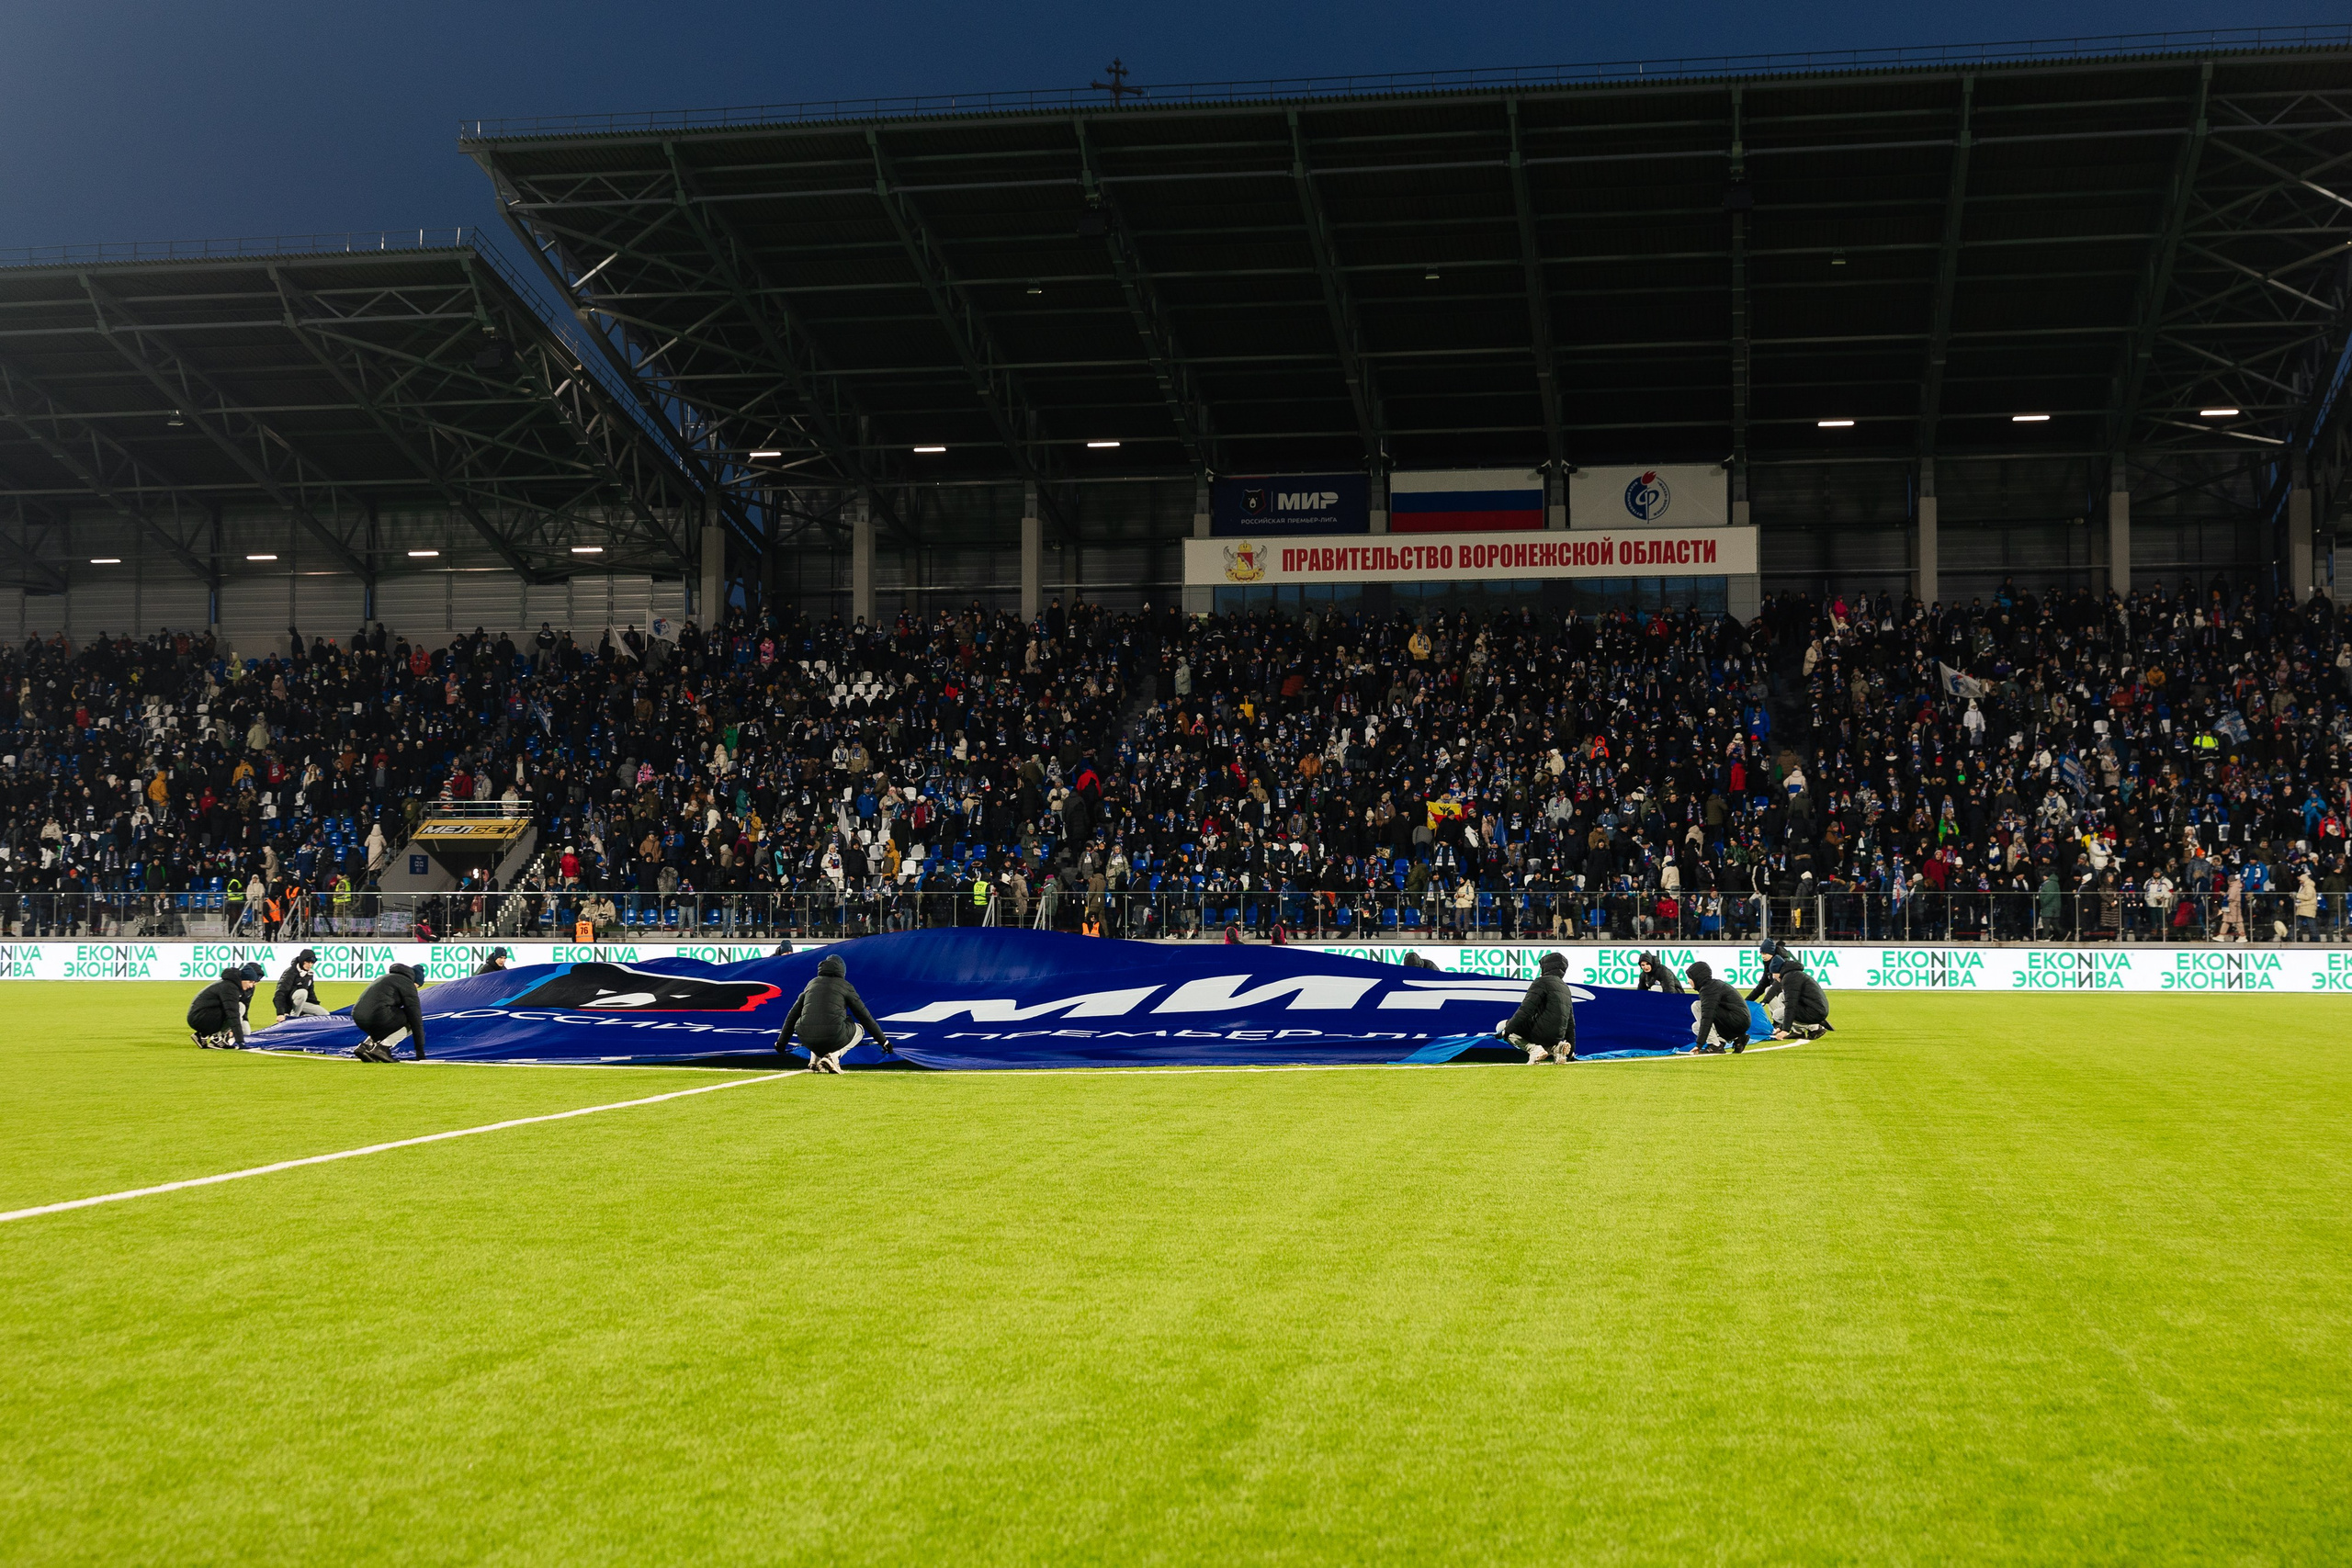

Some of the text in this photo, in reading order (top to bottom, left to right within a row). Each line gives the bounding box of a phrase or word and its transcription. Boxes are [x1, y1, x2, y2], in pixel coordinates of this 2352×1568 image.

[1278, 492, 1339, 511] МИР
[1282, 536, 1716, 572] ПРАВИТЕЛЬСТВО ВОРОНЕЖСКОЙ ОБЛАСТИ
[580, 926, 589, 935] 76
[76, 945, 158, 961] EKONIVA
[193, 945, 276, 961] EKONIVA
[311, 946, 395, 962] EKONIVA
[552, 946, 639, 963] EKONIVA
[676, 947, 763, 963] EKONIVA
[1883, 951, 1984, 968] EKONIVA
[2029, 952, 2132, 969] EKONIVA
[63, 962, 151, 977] ЭКОНИВА
[312, 963, 387, 978] КОНИВА
[2177, 953, 2283, 971] EKONIVA
[1866, 969, 1976, 987] ЭКОНИВА
[2012, 970, 2124, 988] ЭКОНИВА
[2160, 972, 2275, 989] ЭКОНИВА
[876, 974, 1596, 1022] МИР
